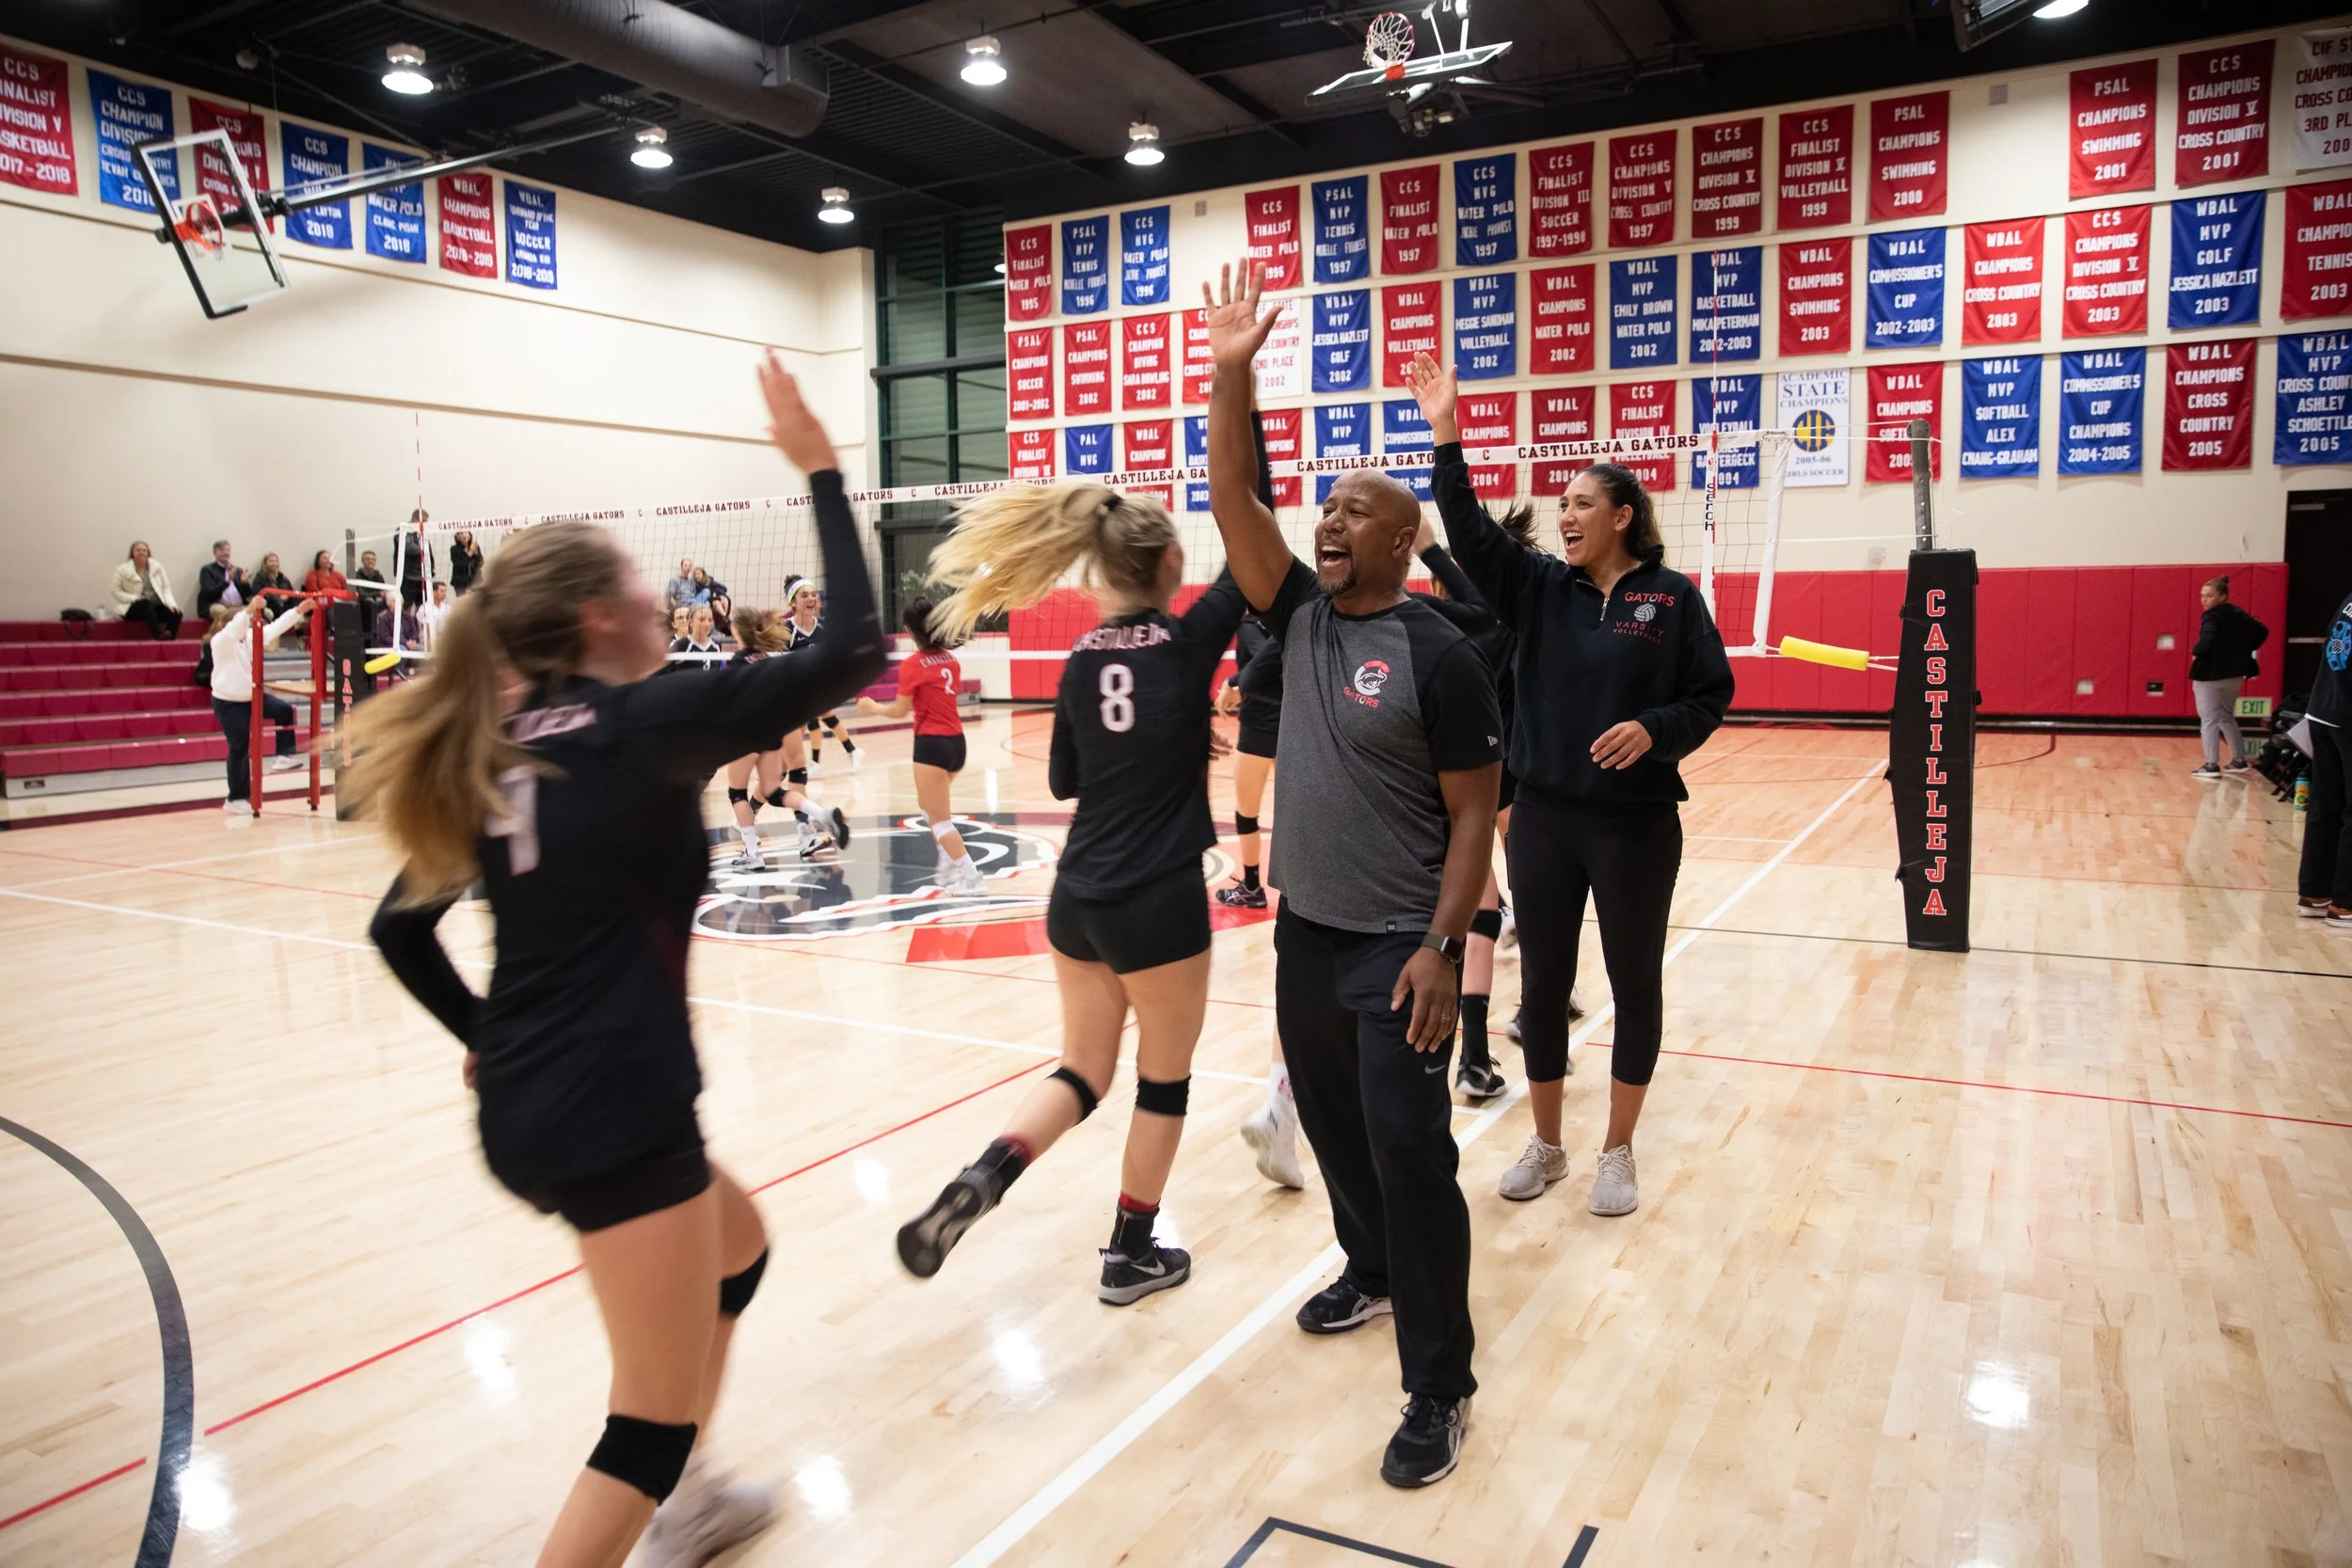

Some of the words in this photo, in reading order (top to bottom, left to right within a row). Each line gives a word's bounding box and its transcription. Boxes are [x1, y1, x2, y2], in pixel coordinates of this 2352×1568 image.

[2312, 40, 2333, 56] CIF
[5, 57, 40, 81] CCS
[2210, 55, 2239, 72] CCS
[2095, 77, 2129, 96] PSAL
[2188, 76, 2259, 101] CHAMPIONS
[2295, 91, 2333, 109] CROSS
[1895, 104, 1924, 120] PSAL
[2077, 103, 2145, 126] CHAMPIONS
[2187, 103, 2239, 124] DIVISION
[2245, 100, 2257, 116] V
[1804, 119, 1828, 134] CCS
[2304, 116, 2328, 132] 3RD
[1714, 126, 1740, 141] CCS
[1879, 130, 1939, 150] CHAMPIONS
[2178, 132, 2213, 149] CROSS
[2216, 123, 2265, 144] COUNTRY
[305, 136, 327, 154] CCS
[1790, 137, 1839, 156] FINALIST
[2081, 132, 2140, 154] SWIMMING
[1701, 146, 1753, 166] CHAMPIONS
[2202, 151, 2238, 170] 2001
[1785, 160, 1829, 177] DIVISION
[1836, 156, 1845, 170] V
[1882, 160, 1935, 180] SWIMMING
[2094, 162, 2125, 180] 2001
[1399, 180, 1420, 194] CCS
[1699, 172, 1739, 189] DIVISION
[1745, 169, 1755, 182] V
[454, 179, 480, 196] WBAL
[1781, 178, 1848, 198] VOLLEYBALL
[1693, 197, 1720, 211] CROSS
[1723, 191, 1759, 208] COUNTRY
[1893, 189, 1922, 205] 2000
[2313, 193, 2352, 211] WBAL
[444, 198, 489, 219] CHAMPIONS
[1390, 200, 1429, 216] FINALIST
[1802, 201, 1826, 216] 1999
[2197, 198, 2237, 215] WBAL
[307, 220, 333, 238] 2018
[1416, 222, 1438, 236] POLO
[1715, 216, 1739, 230] 1999
[1986, 230, 2023, 246] WBAL
[2200, 223, 2231, 240] MVP
[516, 231, 550, 249] SOCCER
[1889, 239, 1925, 255] WBAL
[1398, 247, 1419, 261] 1997
[1800, 247, 1832, 262] WBAL
[2197, 246, 2232, 264] GOLF
[2307, 252, 2352, 270] TENNIS
[1628, 260, 1658, 275] WBAL
[1974, 256, 2032, 275] CHAMPIONS
[1469, 277, 1498, 291] WBAL
[1547, 275, 1576, 290] WBAL
[1788, 272, 1843, 290] CHAMPIONS
[2169, 274, 2210, 291] JESSICA
[2212, 268, 2257, 287] HAZLETT
[1632, 281, 1653, 295] MVP
[1964, 287, 1995, 302] CROSS
[1997, 282, 2042, 300] COUNTRY
[2311, 283, 2346, 300] 2003
[1325, 294, 1353, 308] WBAL
[1473, 295, 1495, 309] MVP
[1538, 298, 1585, 314] CHAMPIONS
[1613, 304, 1637, 317] EMILY
[1643, 299, 1672, 314] BROWN
[1789, 298, 1839, 315] SWIMMING
[1895, 293, 1915, 308] CUP
[2195, 296, 2230, 314] 2003
[1329, 312, 1348, 325] MVP
[1875, 317, 1934, 335] 2002-2003
[1987, 312, 2017, 327] 2003
[1535, 325, 1562, 339] WATER
[1567, 322, 1589, 336] POLO
[1616, 324, 1644, 338] WATER
[1647, 321, 1670, 334] POLO
[1801, 325, 1829, 341] 2003
[1018, 334, 1041, 347] PSAL
[1460, 333, 1509, 349] VOLLEYBALL
[2303, 335, 2348, 352] WBAL
[1330, 350, 1349, 363] GOLF
[1550, 348, 1575, 361] 2002
[1630, 343, 1656, 357] 2002
[2188, 344, 2232, 361] WBAL
[1011, 355, 1047, 369] CHAMPIONS
[1274, 357, 1294, 367] PLACE
[1472, 355, 1497, 368] 2002
[1983, 358, 2020, 374] WBAL
[2083, 353, 2122, 368] WBAL
[2309, 356, 2341, 372] MVP
[1017, 376, 1042, 390] SOCCER
[1265, 377, 1285, 388] 2002
[1329, 369, 1351, 382] 2002
[1781, 370, 1845, 382] ACADEMIC
[2175, 366, 2243, 385] CHAMPIONS
[1783, 381, 1845, 399] STATE
[1988, 382, 2013, 397] MVP
[2278, 377, 2313, 392] CROSS
[1012, 398, 1049, 411] 2001-2002
[1548, 398, 1578, 411] WBAL
[1780, 398, 1848, 408] CHAMPIONS
[2090, 400, 2111, 415] CUP
[2187, 392, 2227, 408] CROSS
[2296, 395, 2344, 412] ASHLEY
[1976, 404, 2028, 420] SOFTBALL
[1539, 421, 1586, 436] CHAMPIONS
[2069, 421, 2130, 438] CHAMPIONS
[2180, 416, 2233, 433] COUNTRY
[1986, 427, 2014, 442] ALEX
[1518, 439, 1624, 459] CASTILLEJA
[1631, 436, 1698, 451] GATORS
[2188, 440, 2221, 456] 2005
[2299, 436, 2339, 451] 2005
[1795, 456, 1831, 465] 2005-06
[2068, 445, 2130, 462] 2004-2005
[1298, 454, 1389, 471] CASTILLEJA
[1104, 469, 1184, 484] CASTILLEJA
[853, 490, 893, 502] GATORS
[594, 510, 625, 521] GATORS
[657, 502, 711, 515] CASTILLEJA
[715, 500, 750, 512] GATORS
[1625, 592, 1675, 607] GATORS
[941, 668, 954, 694] 2
[1100, 664, 1134, 732] 8
[1343, 687, 1379, 707] GATORS
[2243, 701, 2265, 714] EXIT
[1923, 589, 1948, 915] CASTILLEJA
